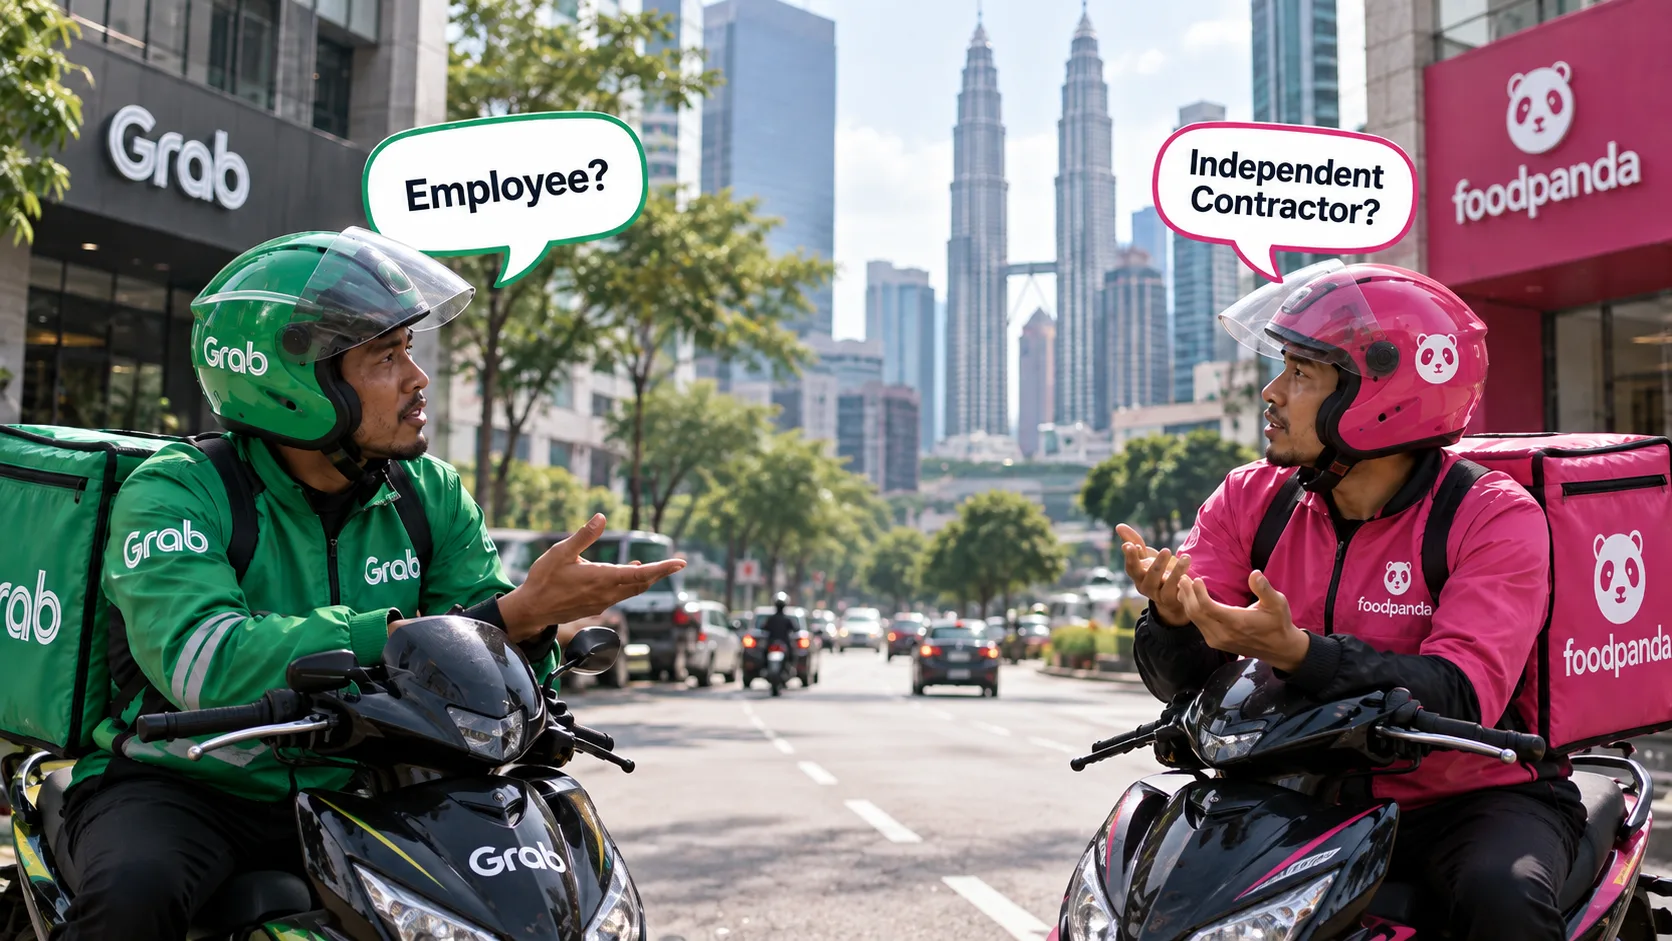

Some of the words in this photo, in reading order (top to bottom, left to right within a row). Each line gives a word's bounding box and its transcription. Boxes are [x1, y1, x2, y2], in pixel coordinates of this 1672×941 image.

[108, 104, 250, 210] Grab
[1452, 141, 1641, 224] foodpanda
[203, 336, 269, 376] Grab
[123, 519, 209, 569] Grab
[364, 548, 421, 585] Grab
[1357, 596, 1432, 618] foodpanda
[1563, 624, 1672, 678] foodpanda
[468, 841, 567, 877] Grab
